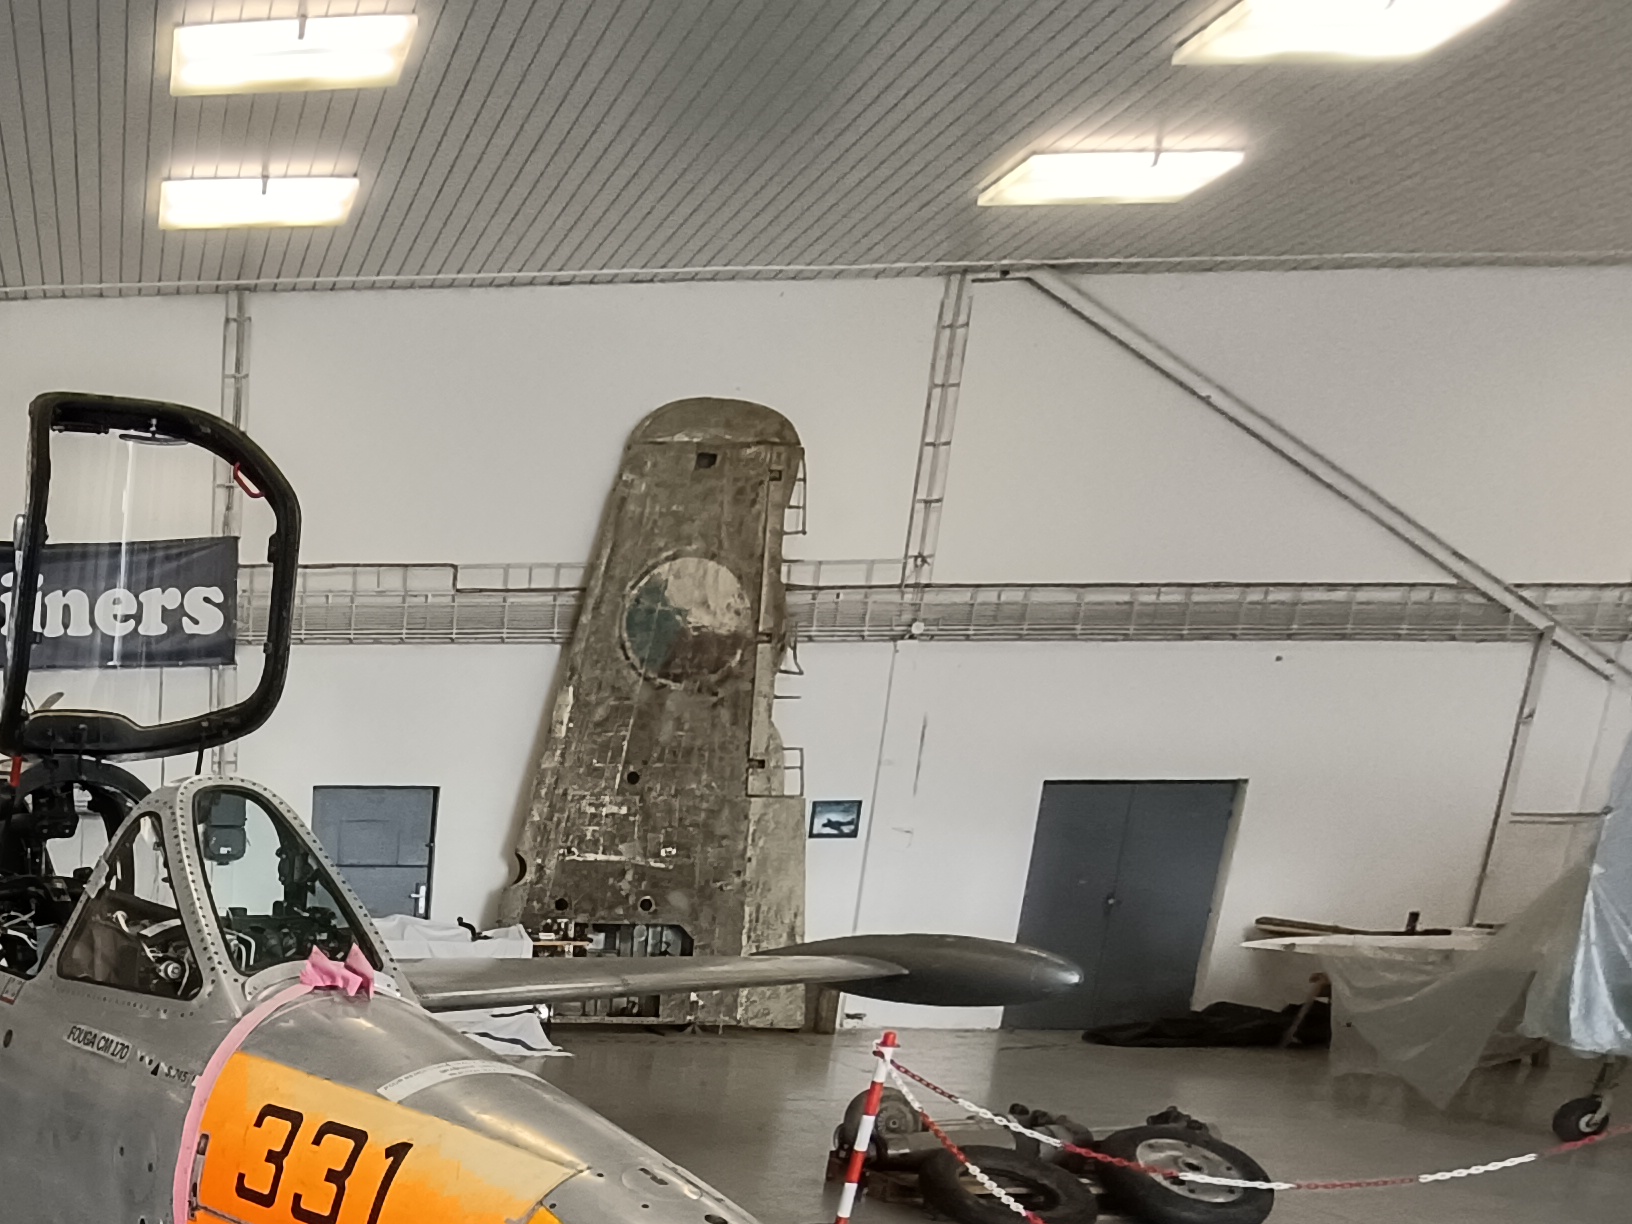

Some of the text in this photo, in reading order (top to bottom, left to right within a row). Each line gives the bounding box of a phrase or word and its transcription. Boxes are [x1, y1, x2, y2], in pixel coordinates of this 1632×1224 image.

[67, 1025, 130, 1060] FOUGA CM 170
